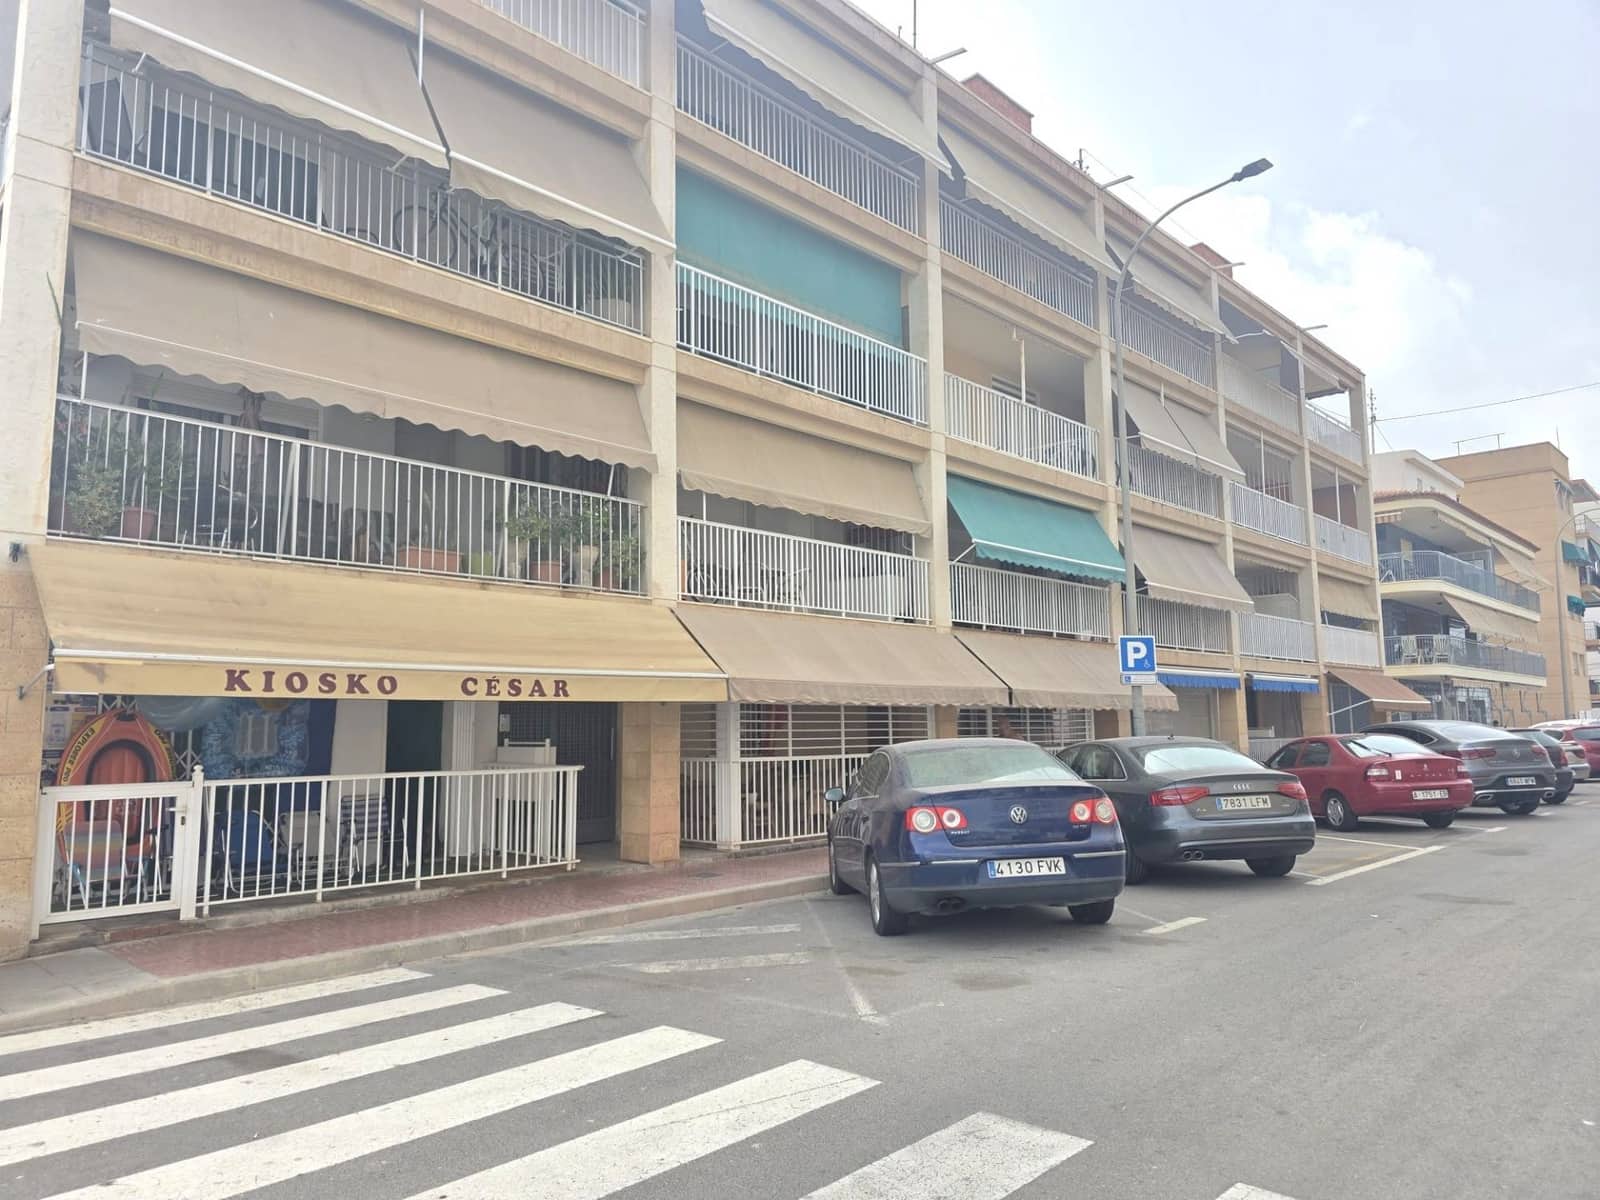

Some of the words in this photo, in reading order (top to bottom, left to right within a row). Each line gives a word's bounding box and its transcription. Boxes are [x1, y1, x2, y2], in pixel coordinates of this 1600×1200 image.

[1127, 641, 1147, 668] P
[224, 669, 398, 695] KIOSKO
[461, 676, 570, 697] CÉSAR
[1223, 798, 1247, 810] 7831
[996, 859, 1033, 875] 4130
[1037, 858, 1062, 873] FVK
